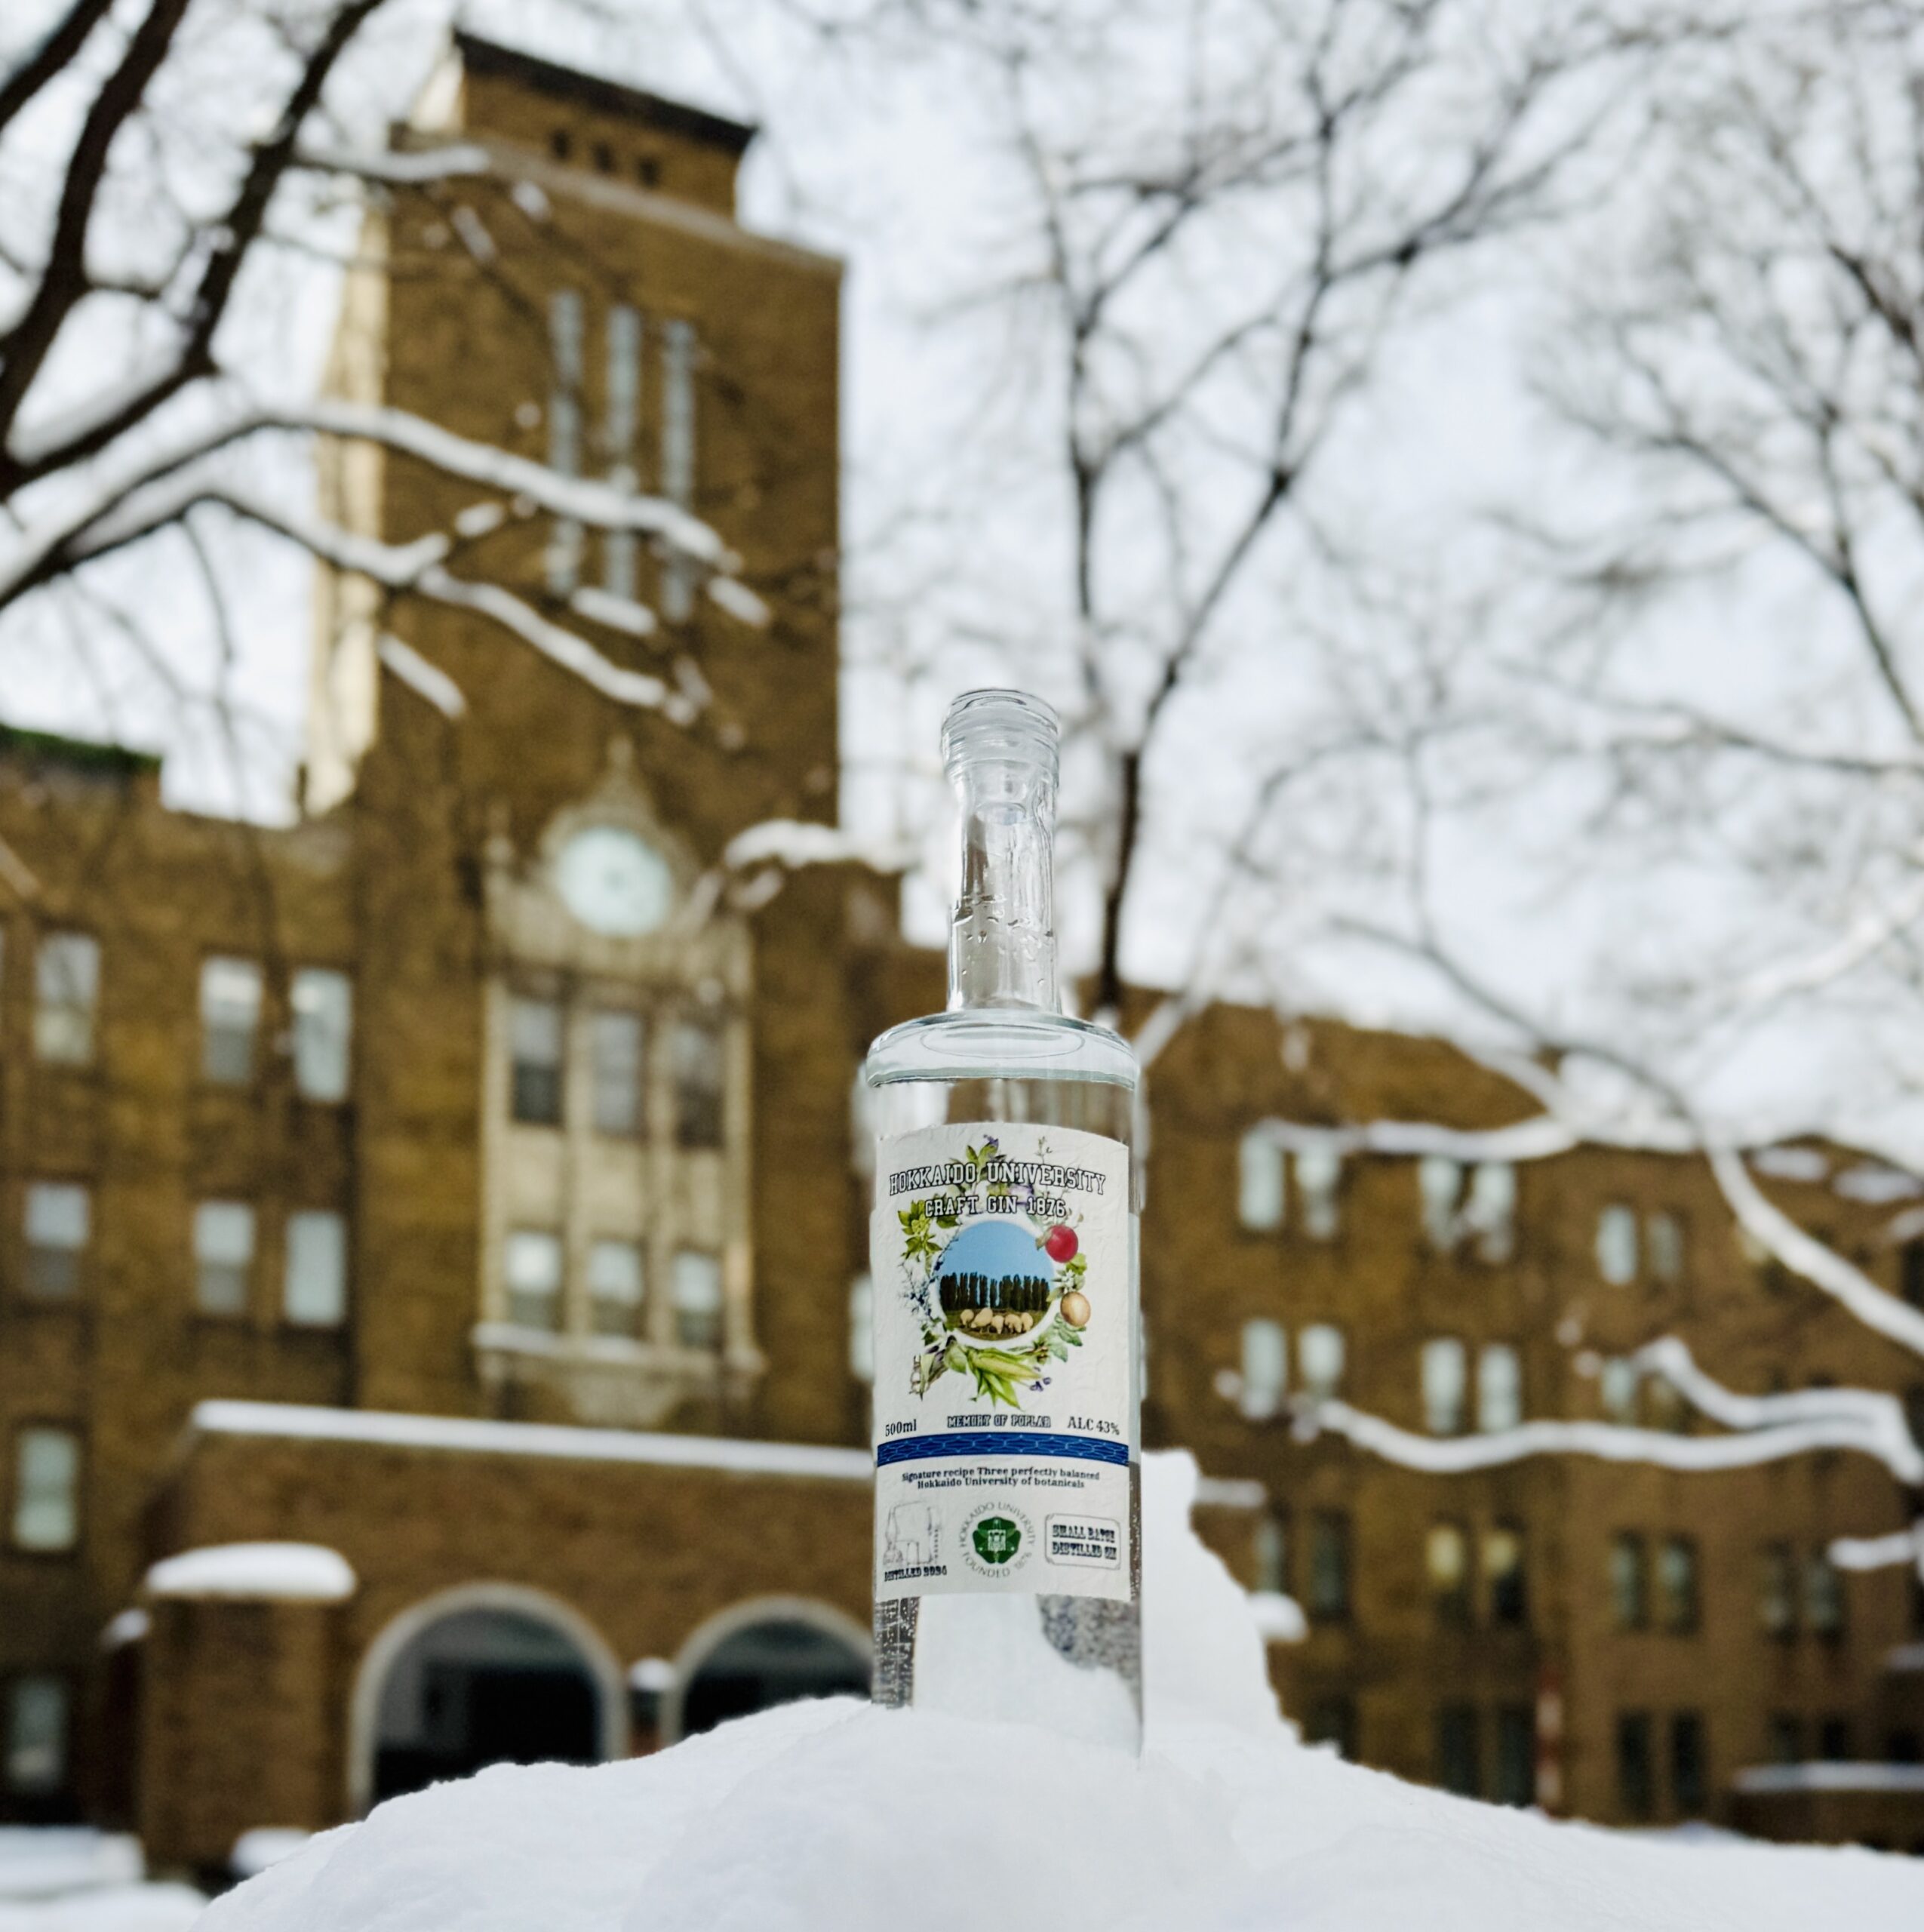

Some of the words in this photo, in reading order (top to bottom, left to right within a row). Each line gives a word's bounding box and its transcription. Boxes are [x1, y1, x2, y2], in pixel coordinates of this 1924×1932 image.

[890, 1163, 977, 1195] HOKKAIDO
[987, 1161, 1106, 1195] UNIVERSITY
[925, 1196, 979, 1217] CRAFT
[988, 1196, 1017, 1214] GIN
[1028, 1197, 1066, 1217] 1876
[885, 1419, 917, 1437] 500ml
[947, 1414, 991, 1428] MEMORY
[994, 1414, 1007, 1426] OF
[1010, 1414, 1051, 1428] POPLAR
[1067, 1416, 1094, 1430] ALC
[1096, 1420, 1120, 1435] 43%
[902, 1470, 942, 1483] Signature
[943, 1467, 975, 1478] recipe
[977, 1466, 1008, 1475] Three
[1011, 1466, 1057, 1477] perfectly
[1059, 1468, 1100, 1480] balanced
[917, 1478, 962, 1489] Hokkaido
[965, 1477, 1019, 1487] University
[1021, 1477, 1032, 1485] of
[1034, 1478, 1085, 1488] botanicals
